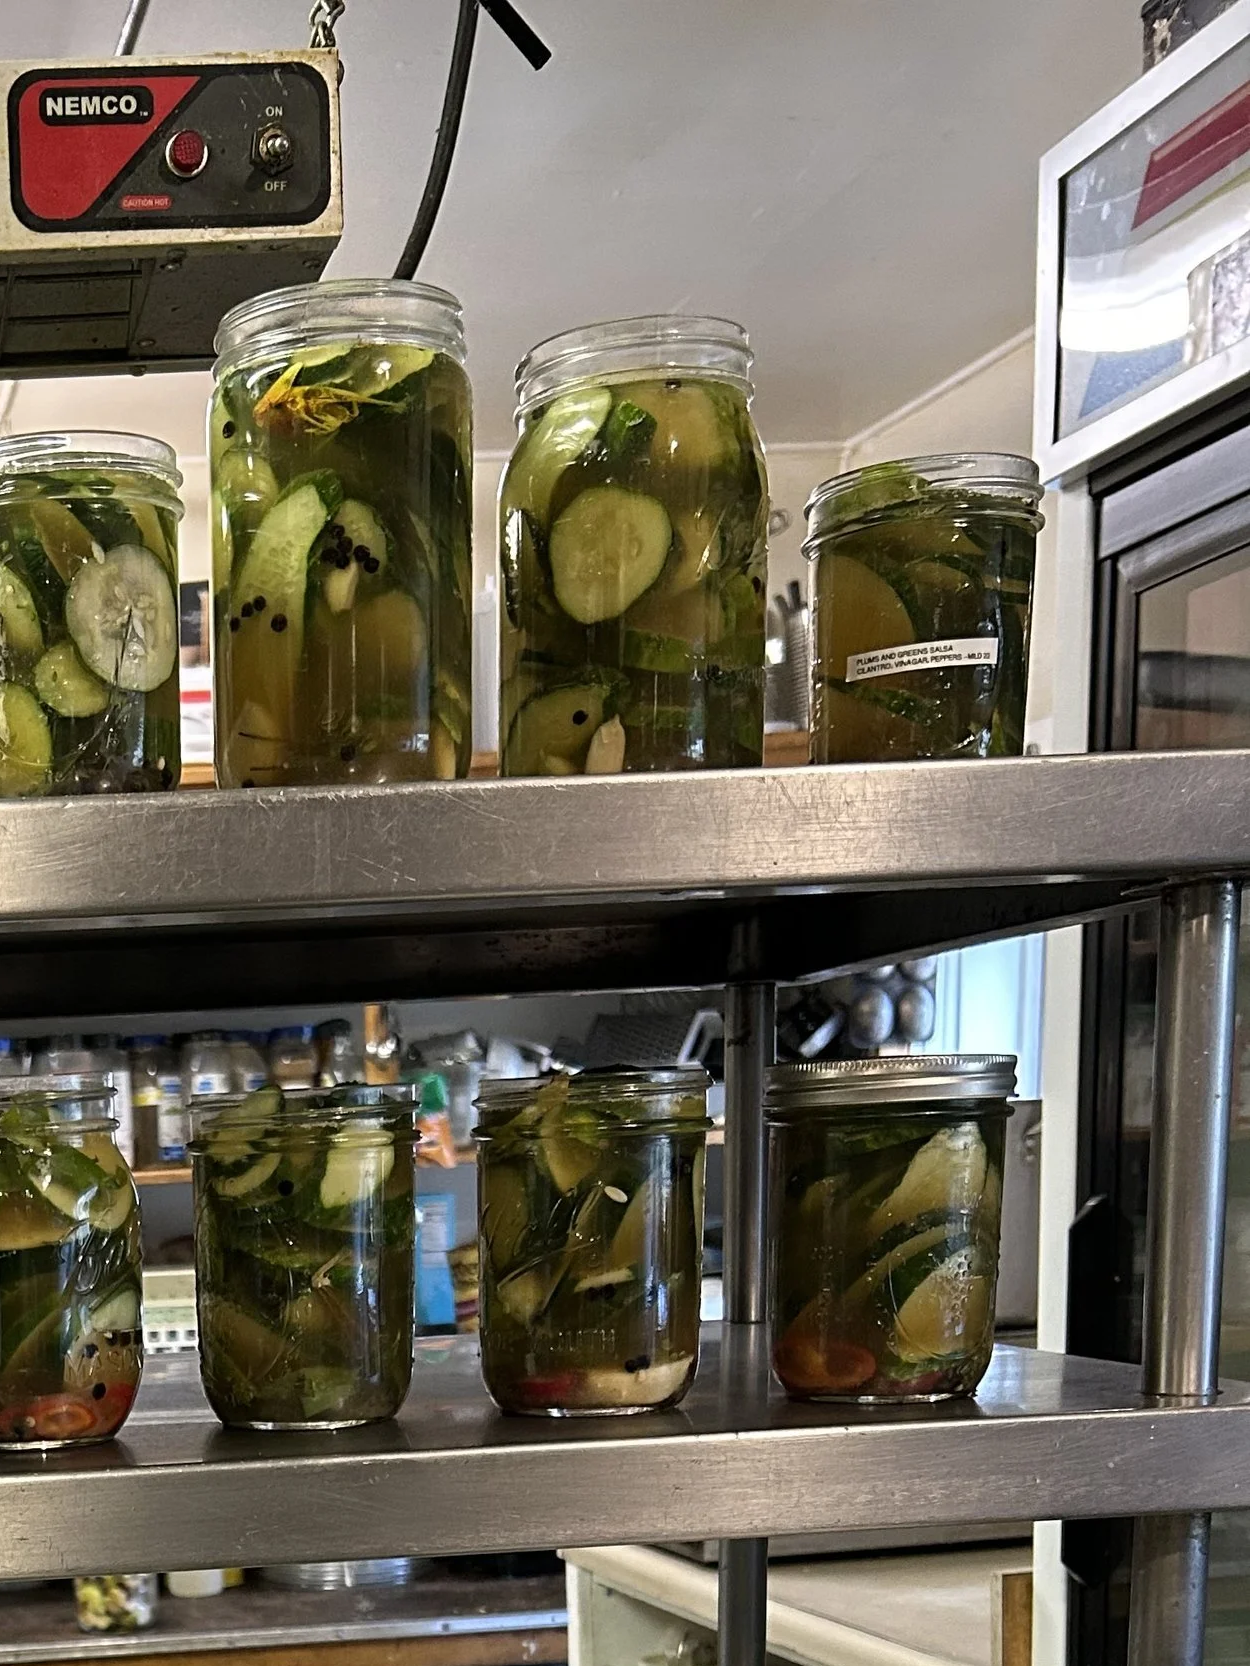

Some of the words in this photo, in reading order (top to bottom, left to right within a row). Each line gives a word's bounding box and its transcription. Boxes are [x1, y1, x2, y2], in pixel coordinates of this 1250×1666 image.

[45, 95, 138, 117] NEMCO
[265, 106, 283, 117] ON
[264, 181, 288, 192] OFF
[123, 198, 154, 208] CAUTION
[154, 198, 169, 207] HOT
[856, 655, 880, 666] PLUMS
[881, 652, 896, 661] AND
[897, 647, 929, 659] GREENS
[929, 645, 954, 654] SALSA
[930, 653, 963, 663] PEPPERS
